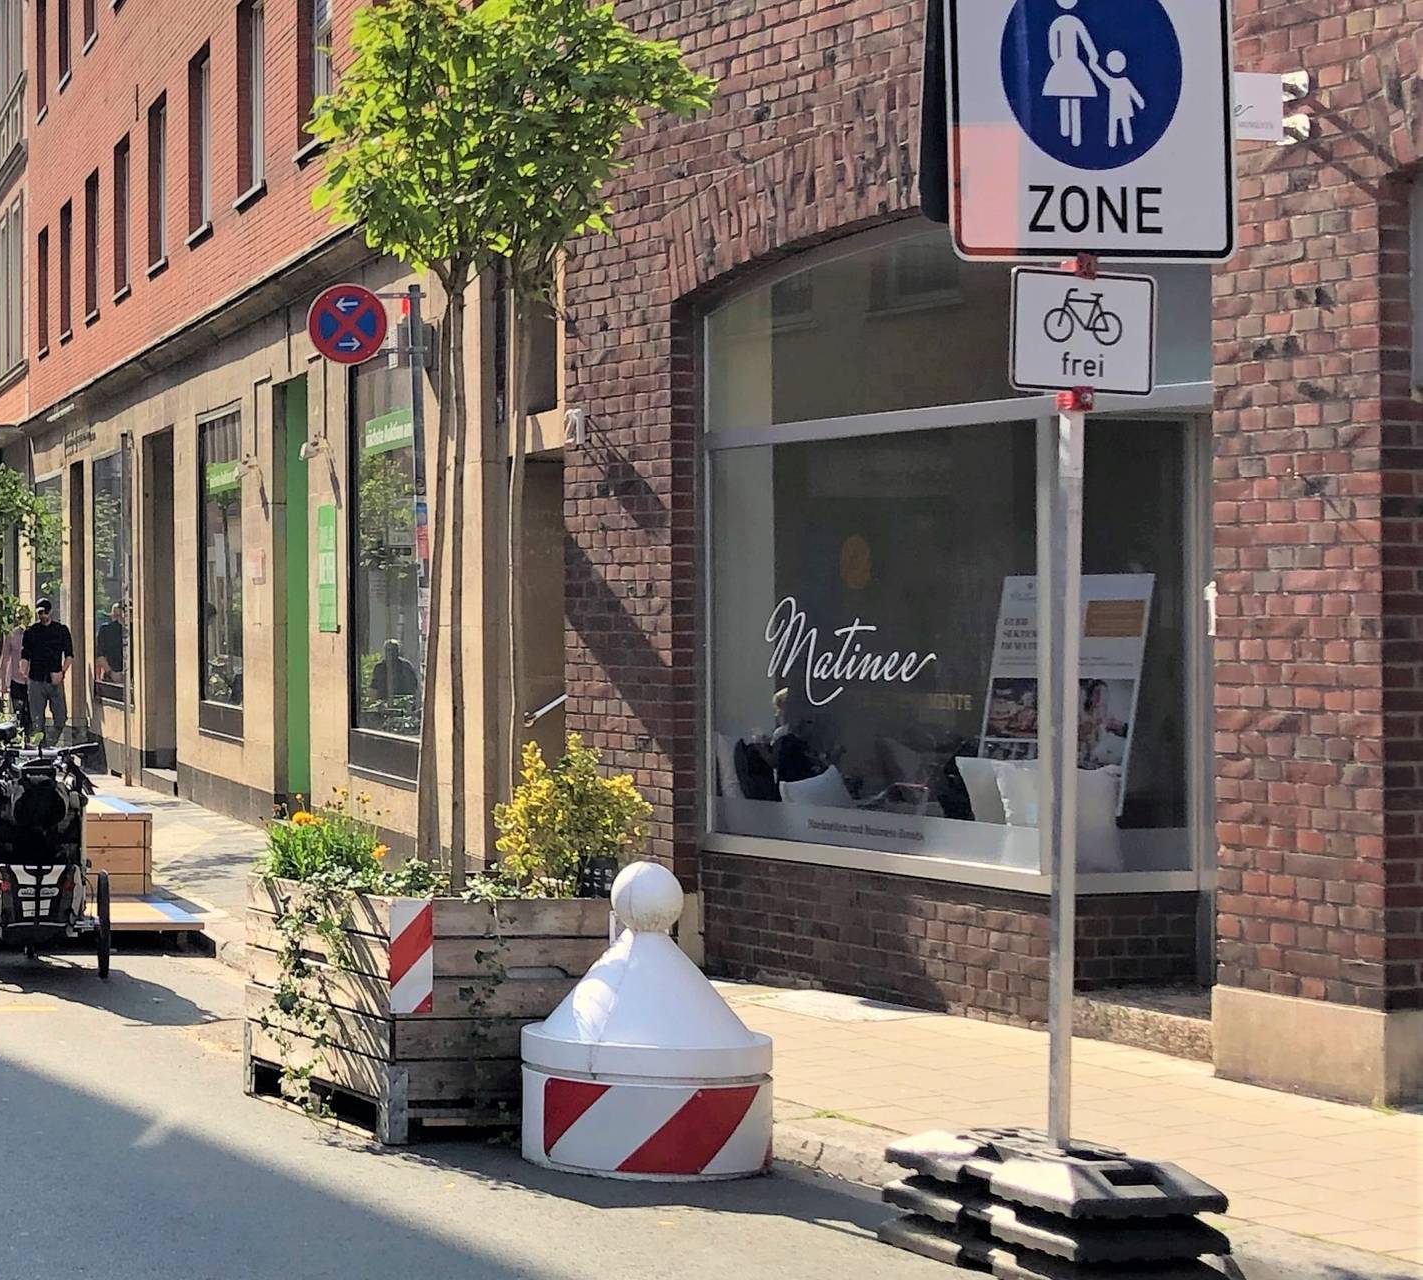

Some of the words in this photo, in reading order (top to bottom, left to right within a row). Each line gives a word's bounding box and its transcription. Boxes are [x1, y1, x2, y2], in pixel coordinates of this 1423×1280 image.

[1028, 184, 1164, 235] ZONE
[1061, 351, 1105, 378] frei
[765, 596, 937, 706] Matinee
